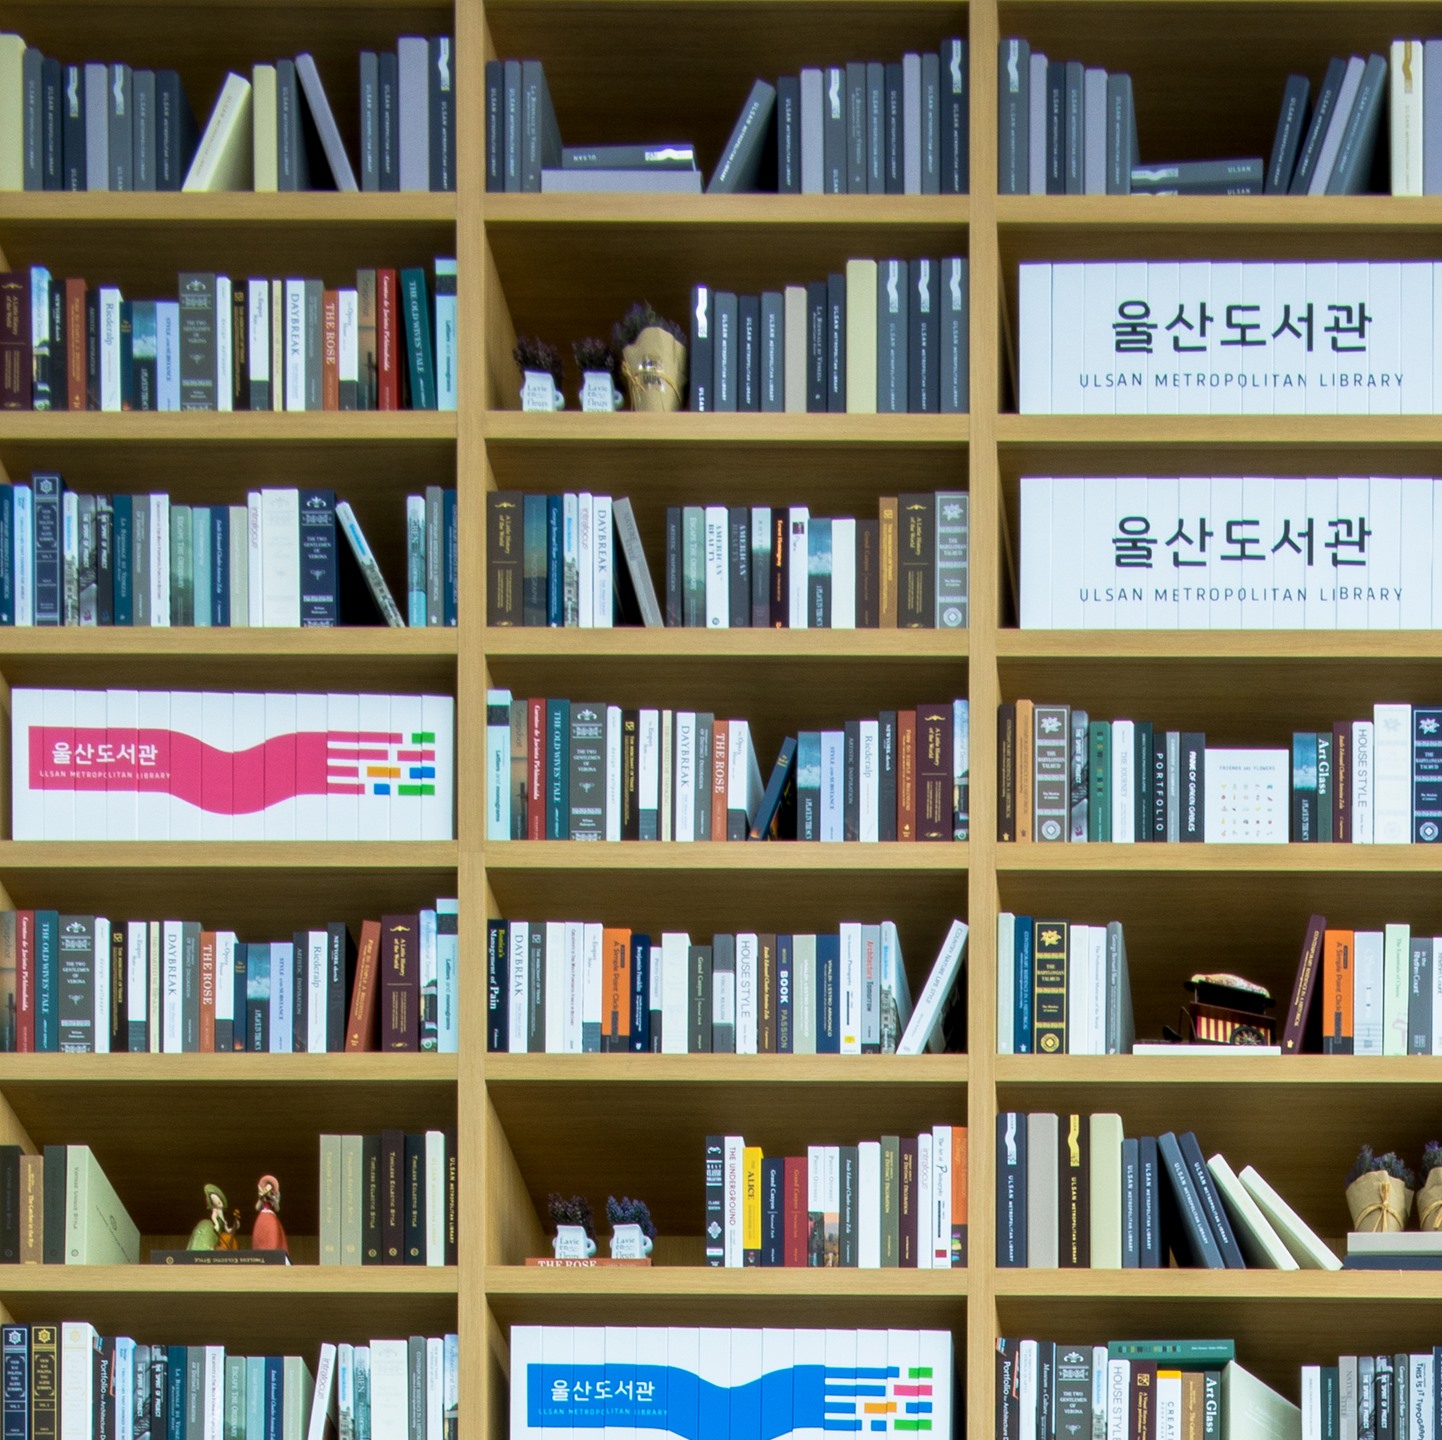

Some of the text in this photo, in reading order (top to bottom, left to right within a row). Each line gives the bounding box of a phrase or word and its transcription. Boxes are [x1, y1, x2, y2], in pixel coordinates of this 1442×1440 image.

[1112, 299, 1372, 354] 울산도서관
[1080, 373, 1404, 388] ULSAN METROPOLITAN LIBRARY
[1112, 515, 1372, 568] 울산도서관
[1080, 586, 1403, 602] ULSAN METROPOLITAN LIBRARY
[52, 741, 158, 766] 울산도서관
[1156, 753, 1164, 831] PORTFOLIO
[168, 933, 178, 996] DAYBREAK
[740, 941, 749, 1018] HOUSE STYLE
[780, 970, 788, 1004] BOOK
[551, 1378, 655, 1402] 울산도서관
